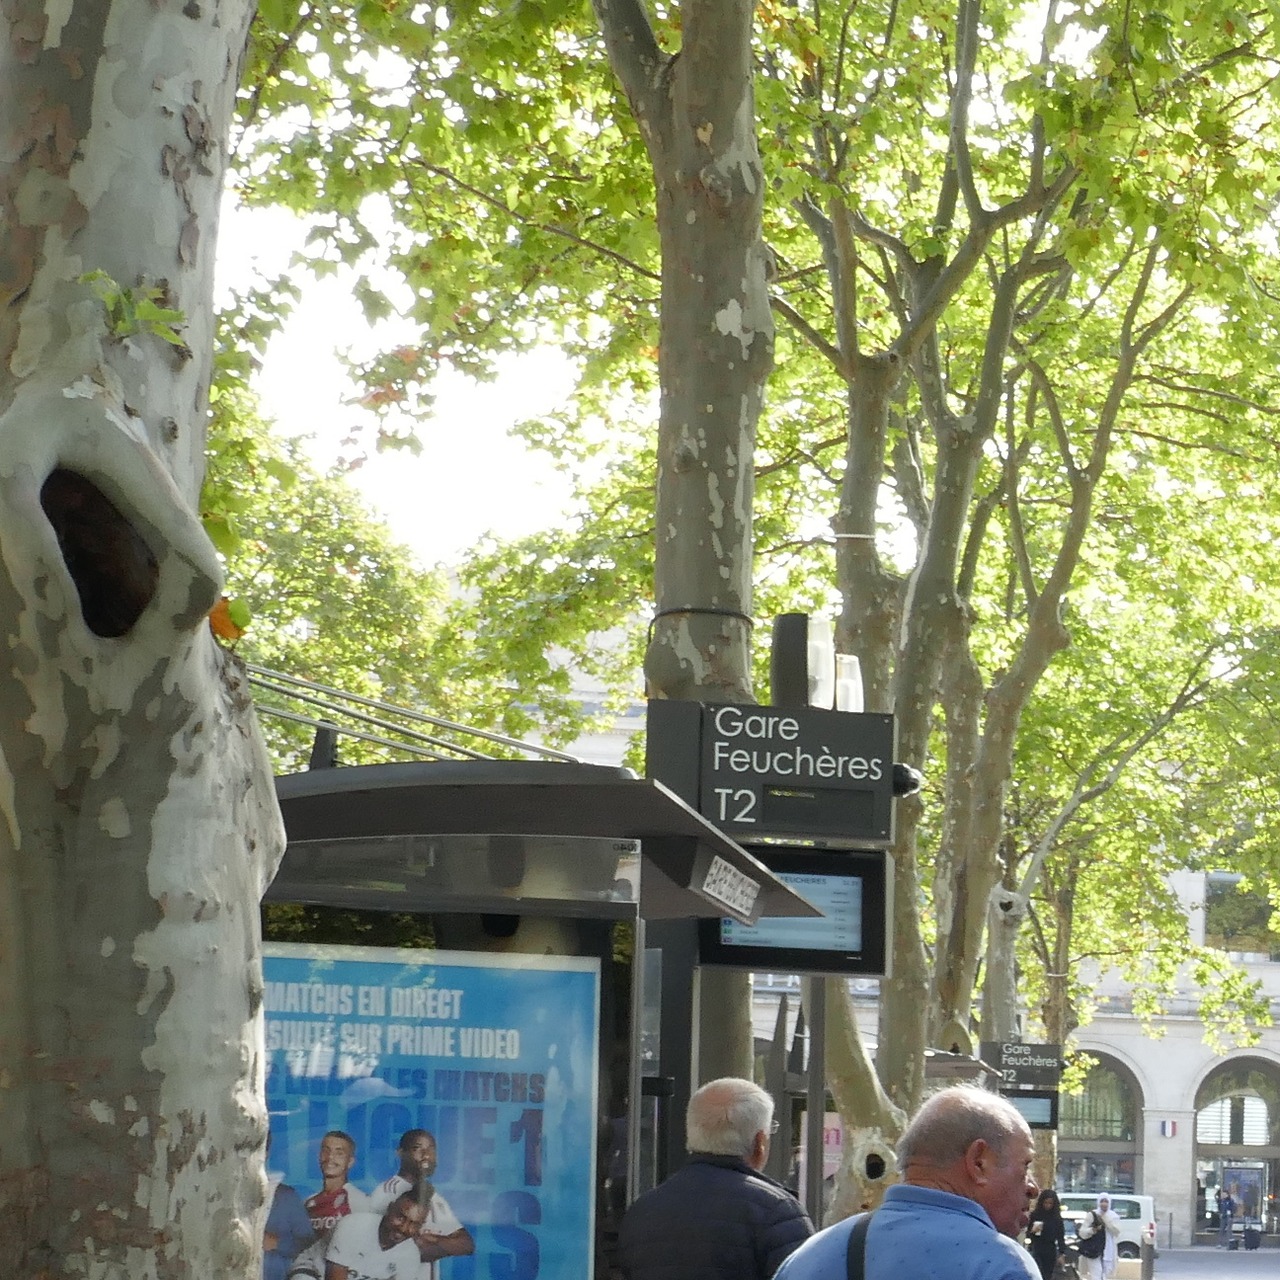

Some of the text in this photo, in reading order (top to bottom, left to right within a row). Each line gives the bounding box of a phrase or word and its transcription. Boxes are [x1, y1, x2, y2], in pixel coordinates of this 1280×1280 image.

[714, 706, 800, 741] Gare
[713, 741, 883, 782] Feuchères
[714, 788, 757, 824] T2
[357, 986, 386, 1017] EN
[390, 987, 464, 1020] DIRECT
[340, 1022, 382, 1054] SUR
[386, 1024, 456, 1057] PRIME
[459, 1027, 520, 1060] VIDEO
[1002, 1043, 1031, 1055] Gare
[1001, 1055, 1058, 1068] Feuchères
[1001, 1070, 1017, 1082] T2
[434, 1069, 546, 1104] MATCHS
[509, 1109, 544, 1187] 1
